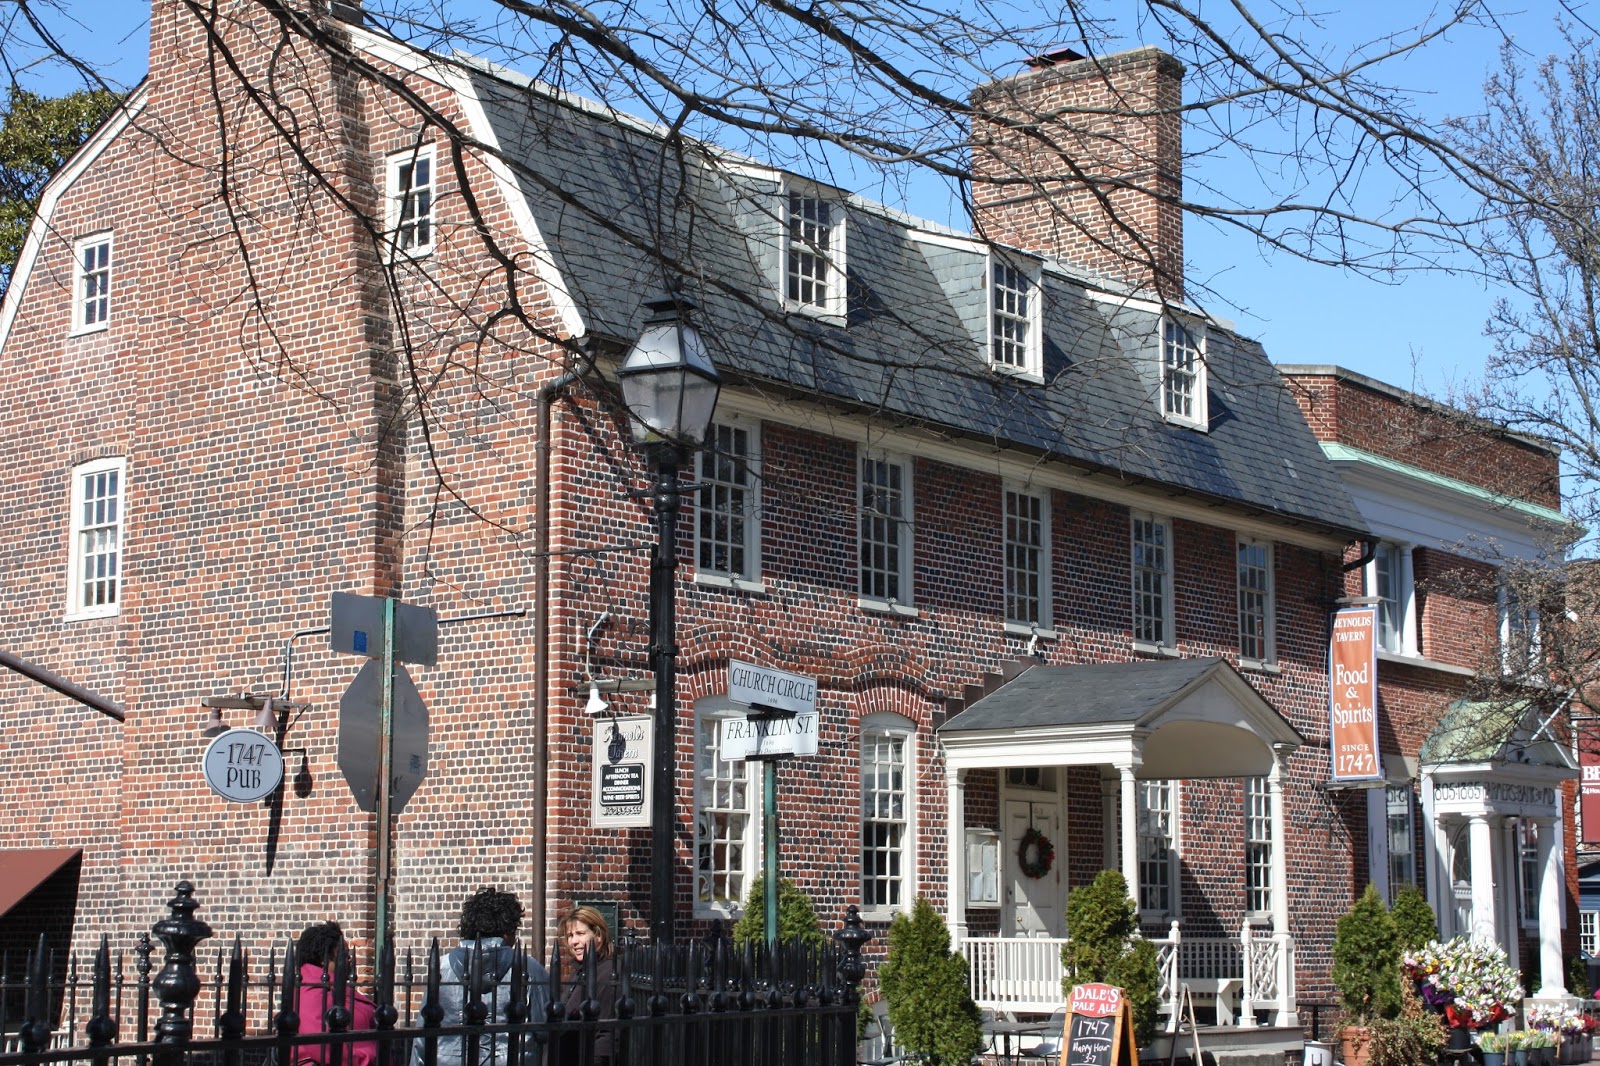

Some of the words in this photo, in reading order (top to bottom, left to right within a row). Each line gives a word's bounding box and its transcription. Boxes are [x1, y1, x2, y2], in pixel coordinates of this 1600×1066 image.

[1334, 617, 1371, 628] REYNOLDS
[1336, 631, 1365, 642] TAVERN
[1335, 662, 1368, 685] Food
[732, 667, 776, 693] CHURCH
[777, 678, 813, 702] CIRCLE
[1345, 687, 1359, 698] &
[1334, 702, 1372, 728] Spirits
[726, 718, 793, 739] FRANKLIN
[795, 715, 813, 734] ST.
[608, 743, 638, 758] Tavern
[1339, 753, 1373, 772] 1747
[226, 767, 261, 789] PUB
[1074, 986, 1119, 1003] DALE'S
[1072, 1001, 1095, 1012] PALE
[1097, 1004, 1117, 1014] ALE
[1078, 1020, 1110, 1037] 1747
[1072, 1041, 1092, 1054] Happy
[1093, 1042, 1110, 1052] Hour
